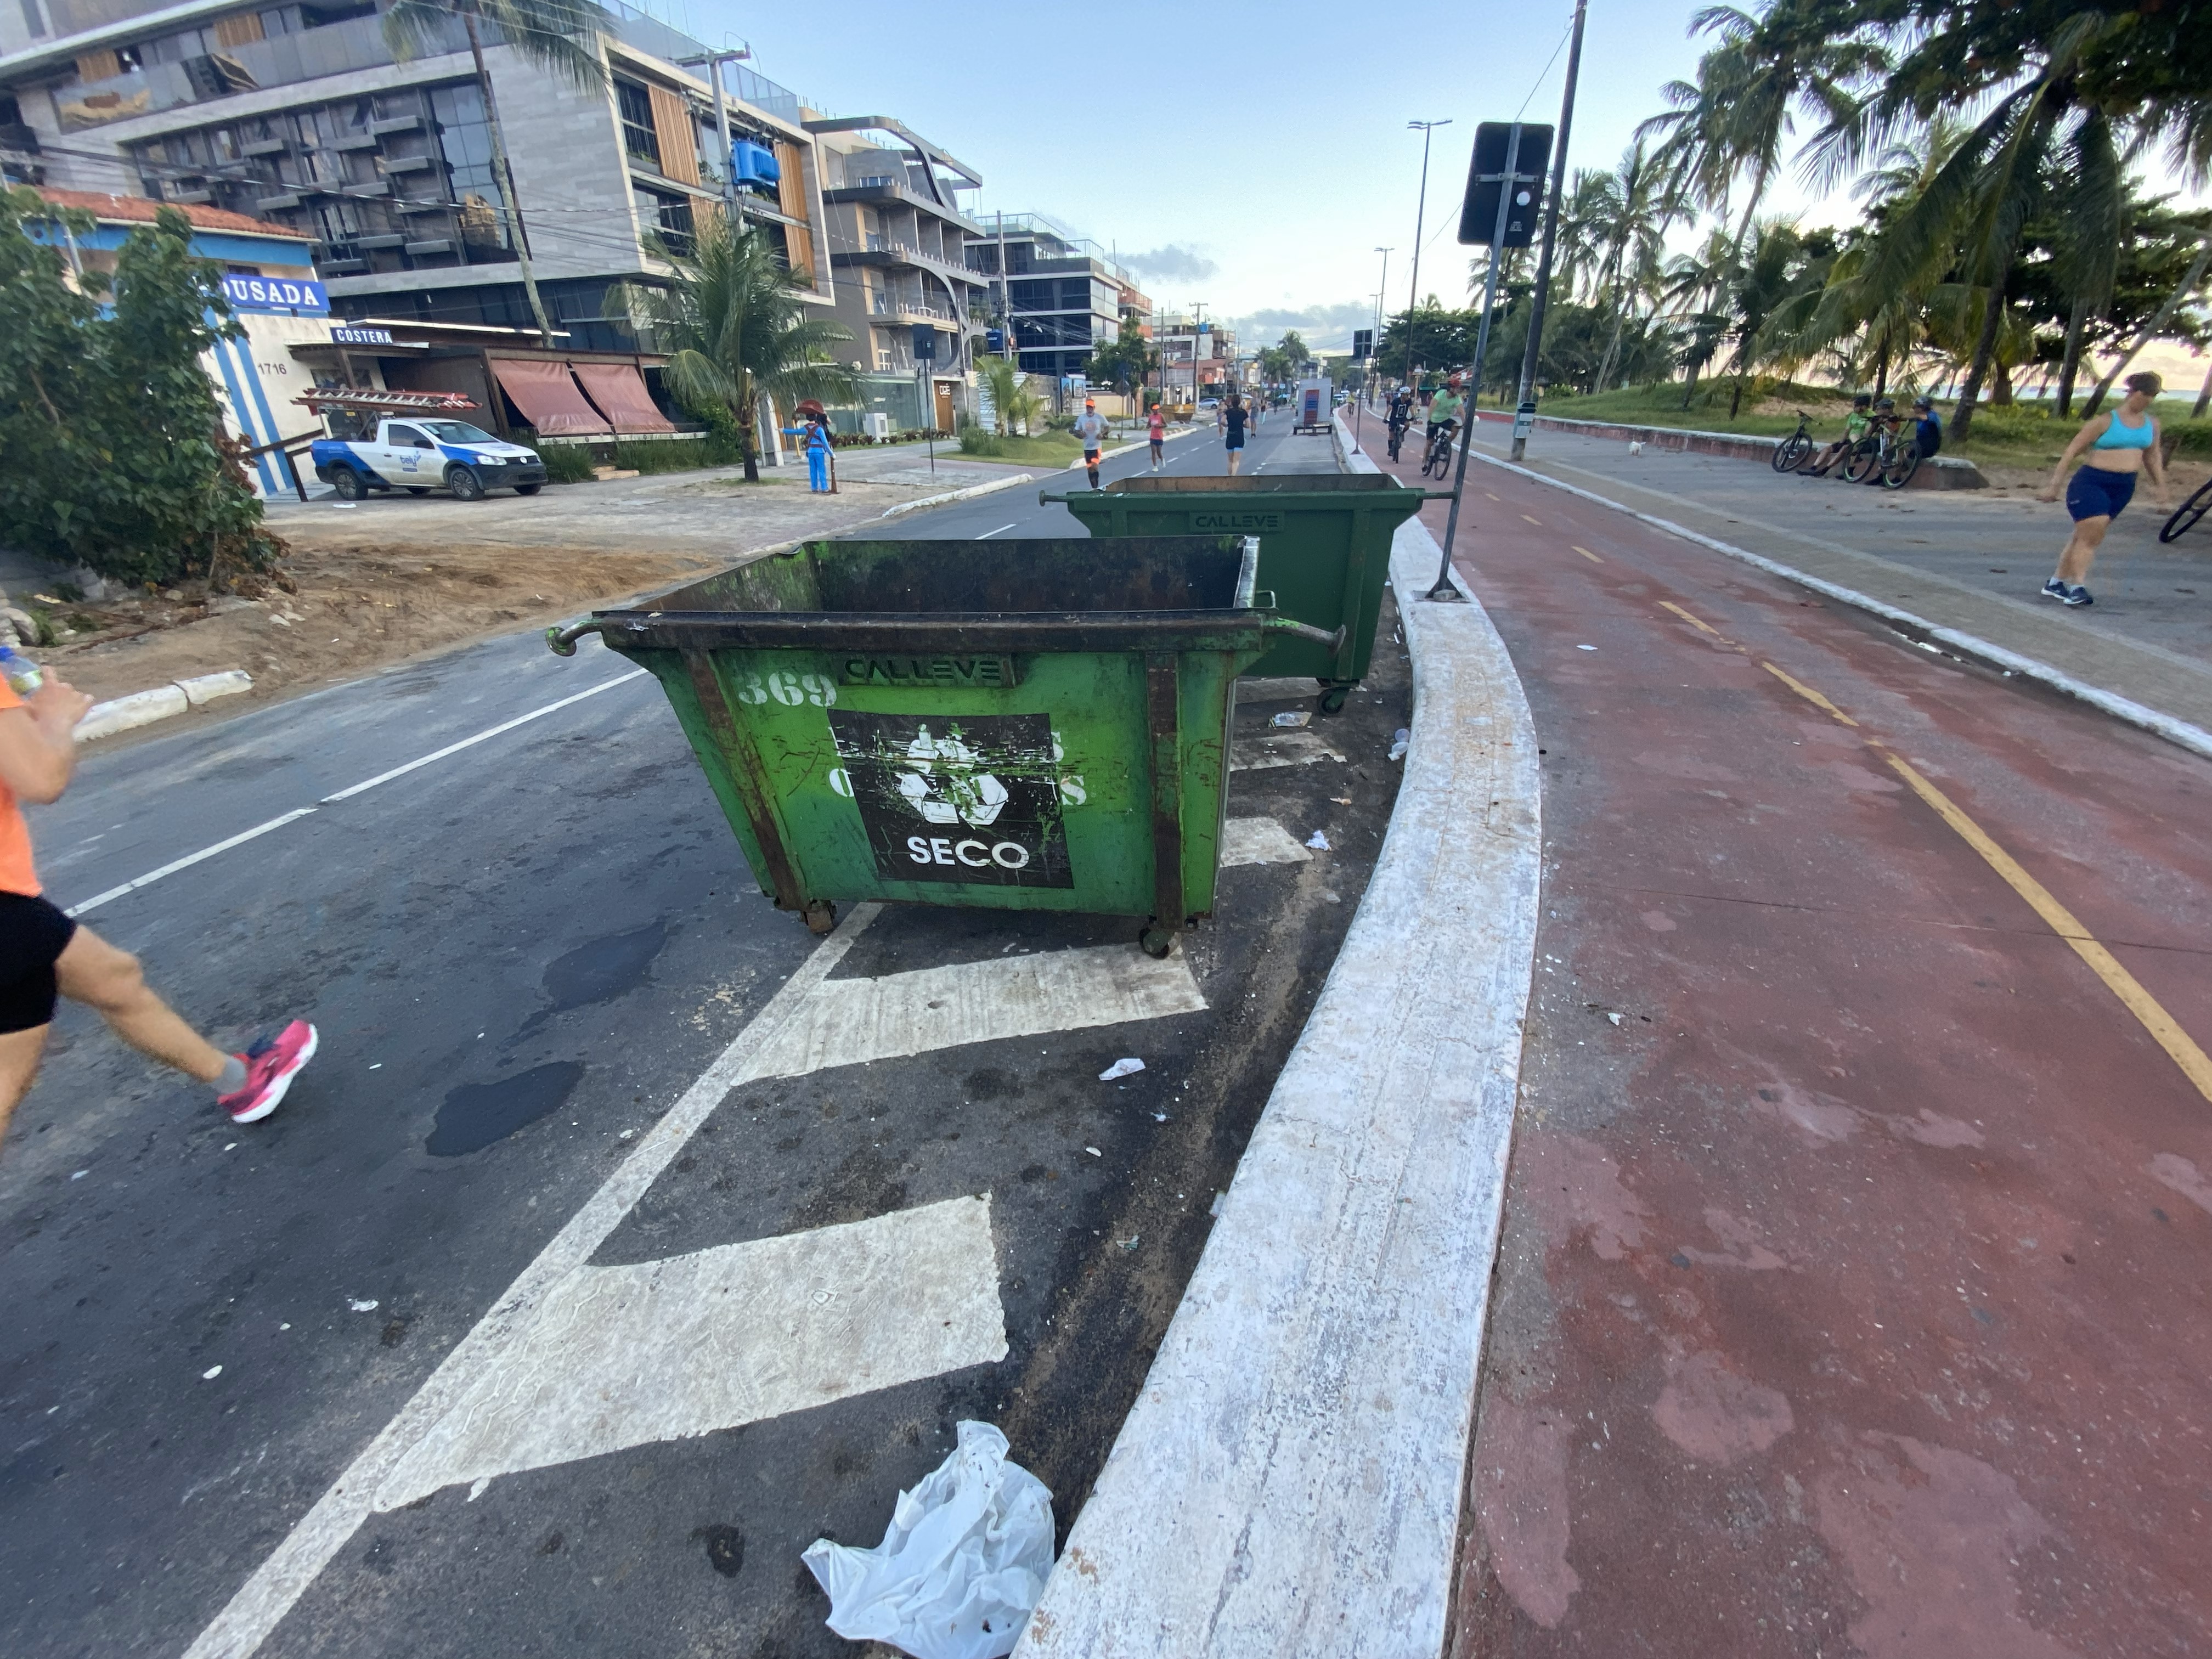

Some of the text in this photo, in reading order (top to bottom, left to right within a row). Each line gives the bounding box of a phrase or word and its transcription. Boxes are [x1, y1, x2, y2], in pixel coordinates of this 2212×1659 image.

[337, 329, 393, 344] COSTERA
[258, 363, 286, 375] 1716
[1195, 515, 1278, 528] CALLEVE
[844, 658, 1000, 680] CALLEVE
[738, 671, 838, 708] 369
[907, 836, 1030, 869] SECO
